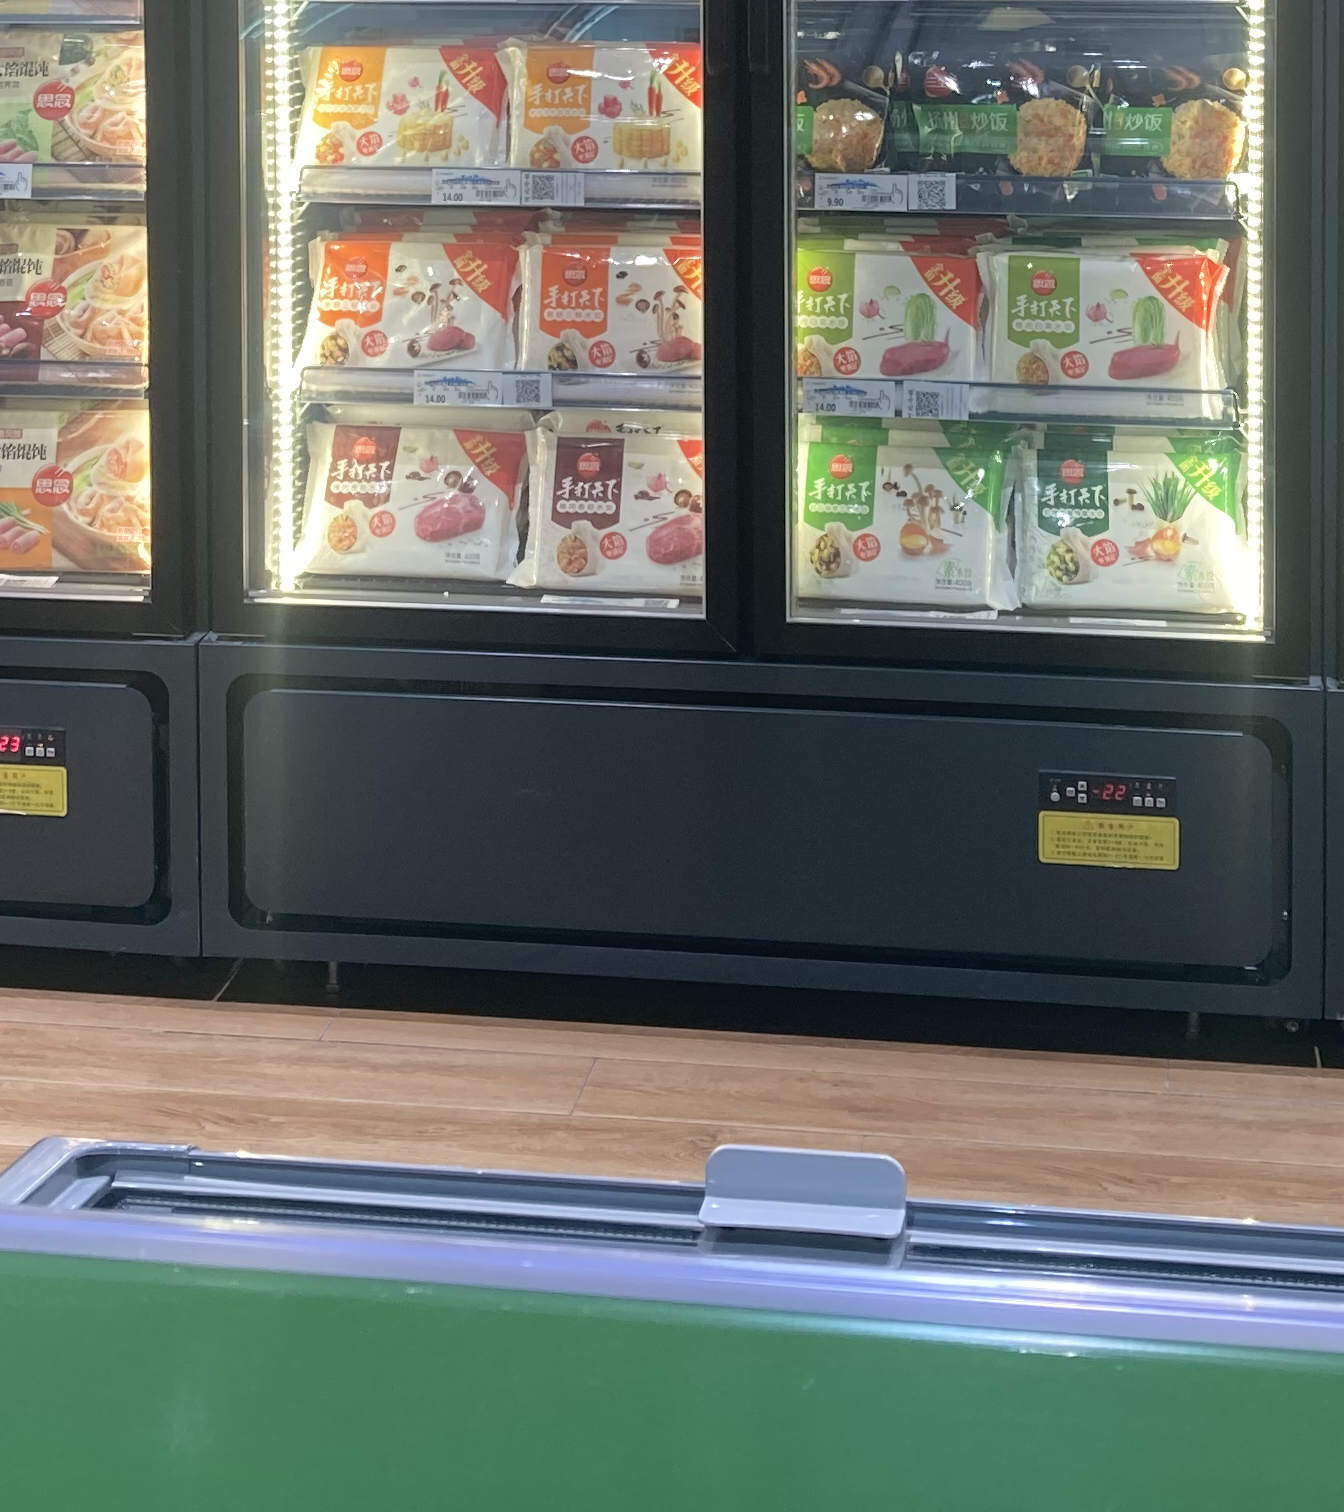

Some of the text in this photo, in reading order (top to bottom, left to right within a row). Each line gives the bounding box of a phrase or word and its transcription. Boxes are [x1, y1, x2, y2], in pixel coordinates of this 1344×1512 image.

[36, 93, 72, 110] 思念
[826, 198, 845, 207] 9.90
[545, 288, 605, 309] 手打天下
[1011, 294, 1077, 319] 手打天下
[35, 479, 70, 495] 思念
[557, 479, 618, 500] 手打天下
[808, 479, 872, 503] 手打天下
[1040, 484, 1106, 507] 手打天下
